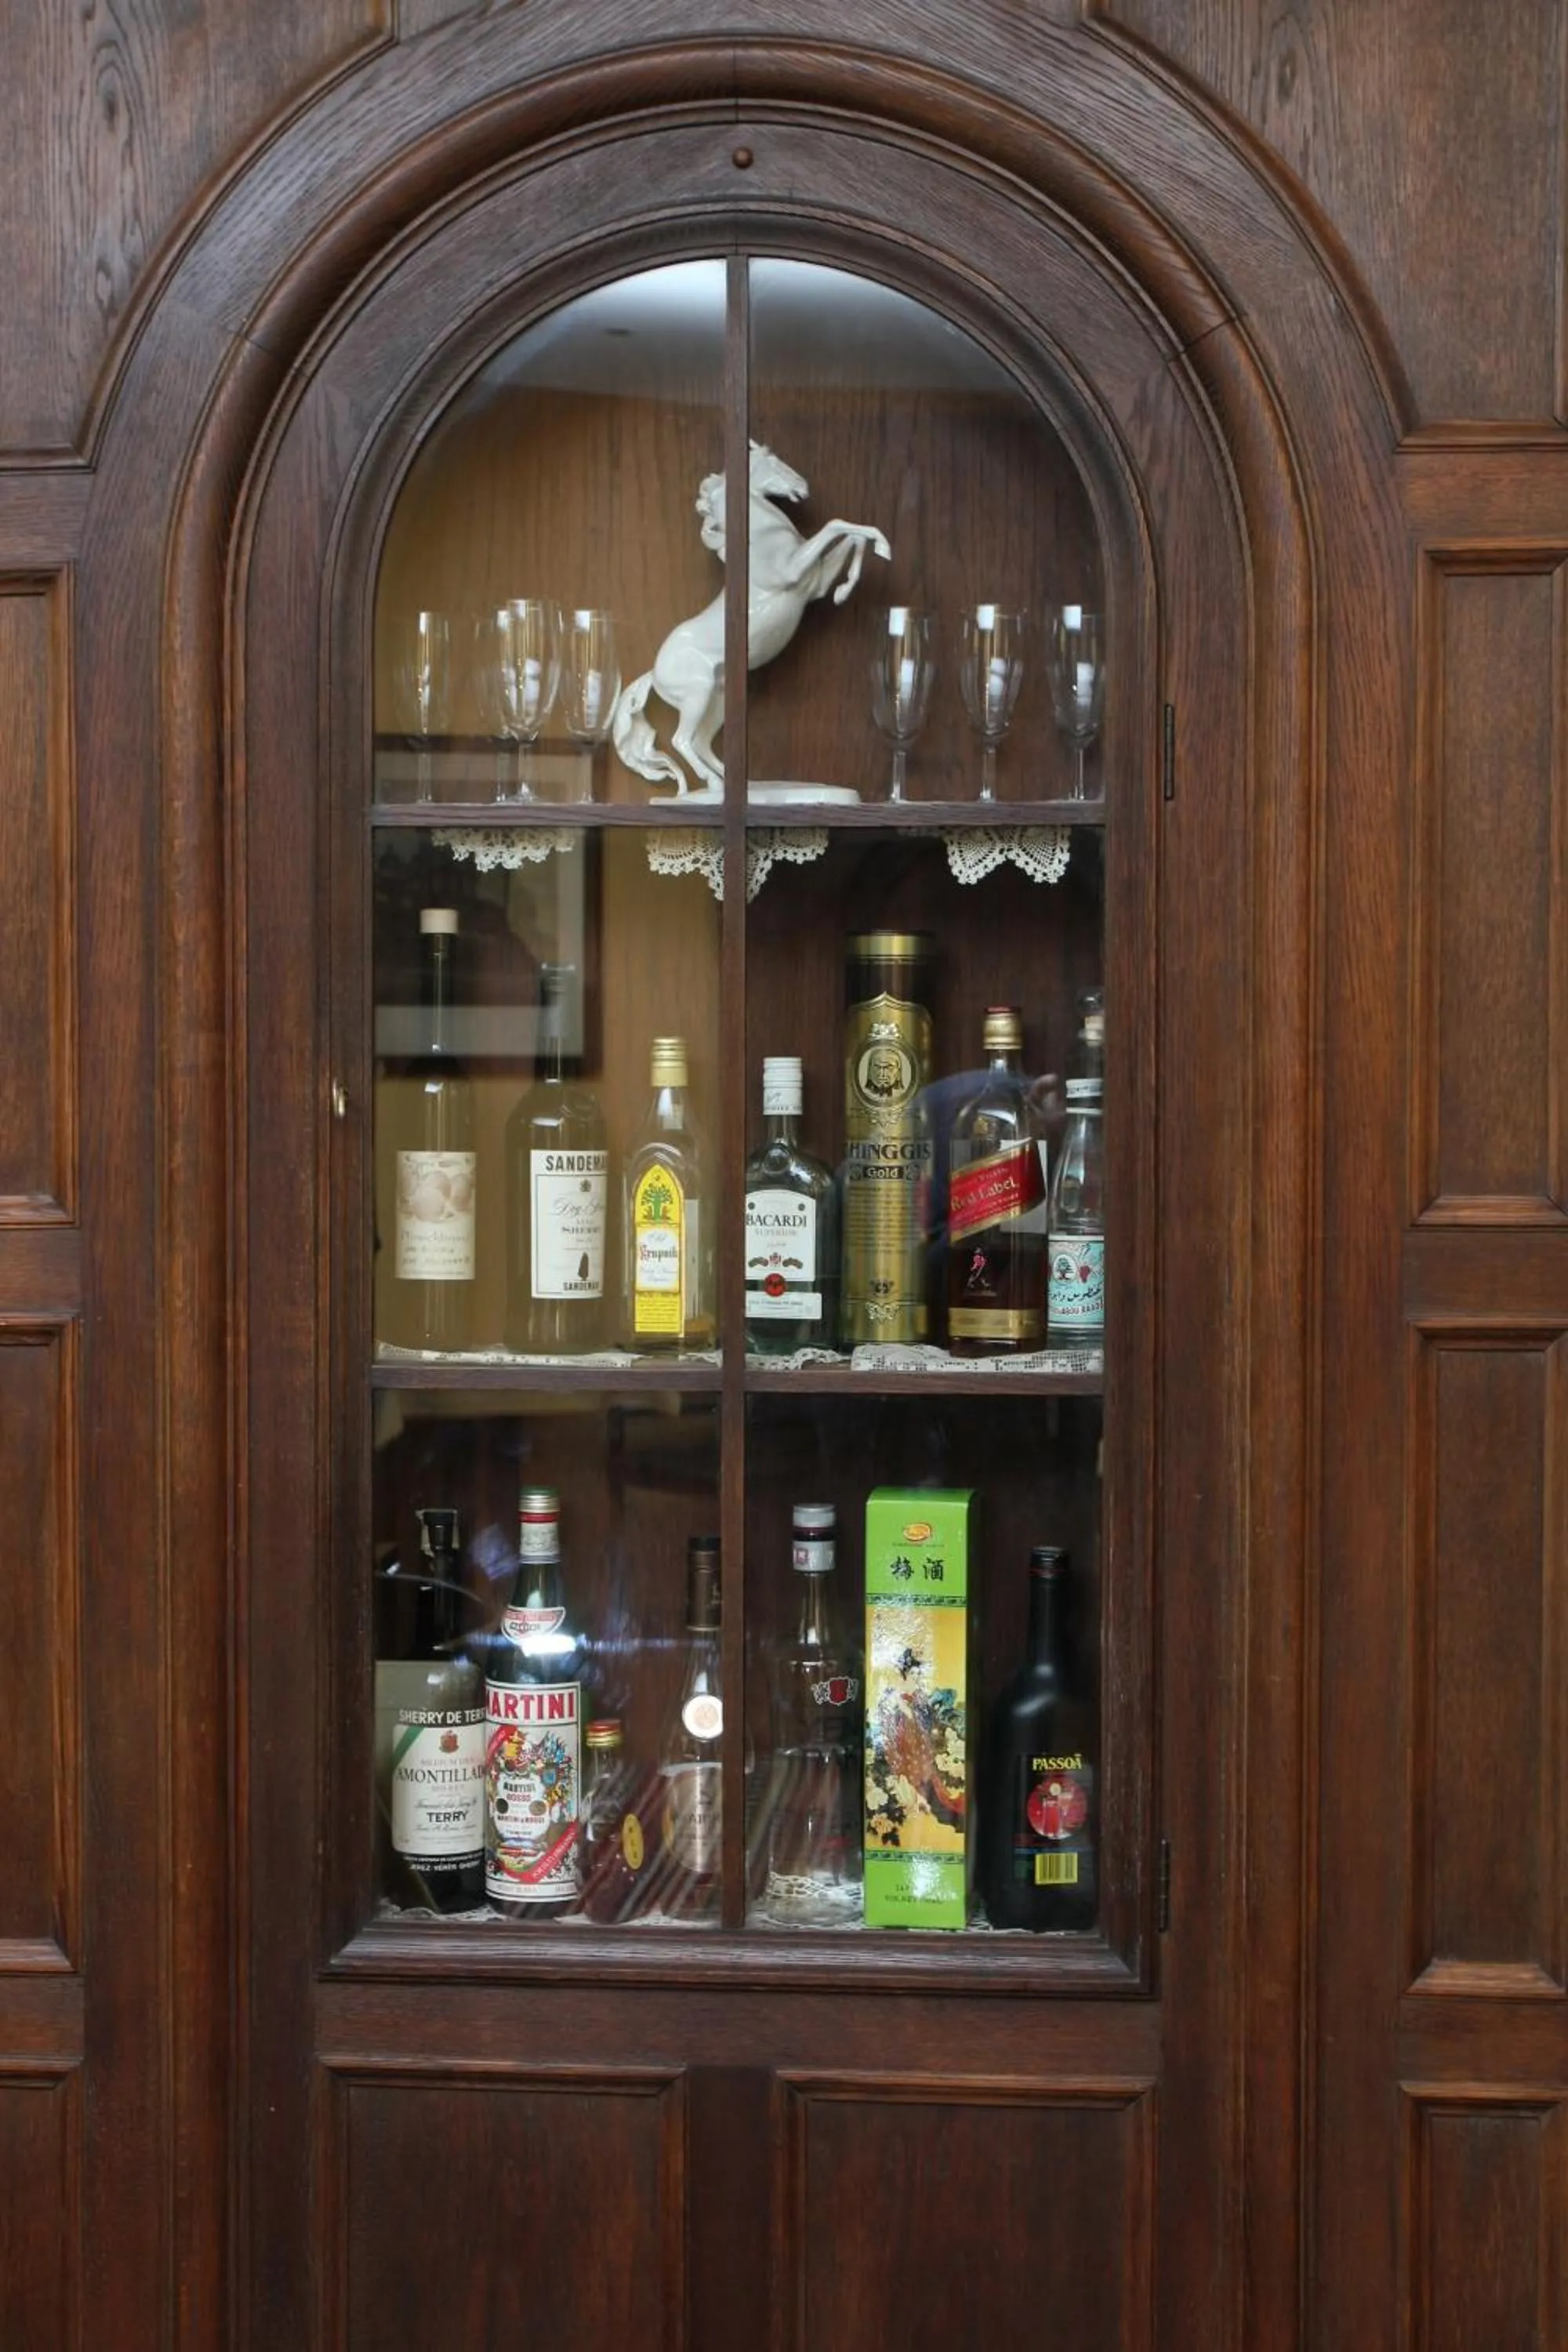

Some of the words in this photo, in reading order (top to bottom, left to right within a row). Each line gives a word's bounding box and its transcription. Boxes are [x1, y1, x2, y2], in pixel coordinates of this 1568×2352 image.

[867, 1167, 898, 1178] Gold
[978, 1175, 1016, 1200] Label
[746, 1214, 807, 1228] BACARDI
[398, 1709, 444, 1725] SHERRY
[446, 1711, 462, 1724] DE
[395, 1765, 485, 1784] AMONTILLAD
[426, 1810, 469, 1823] TERRY
